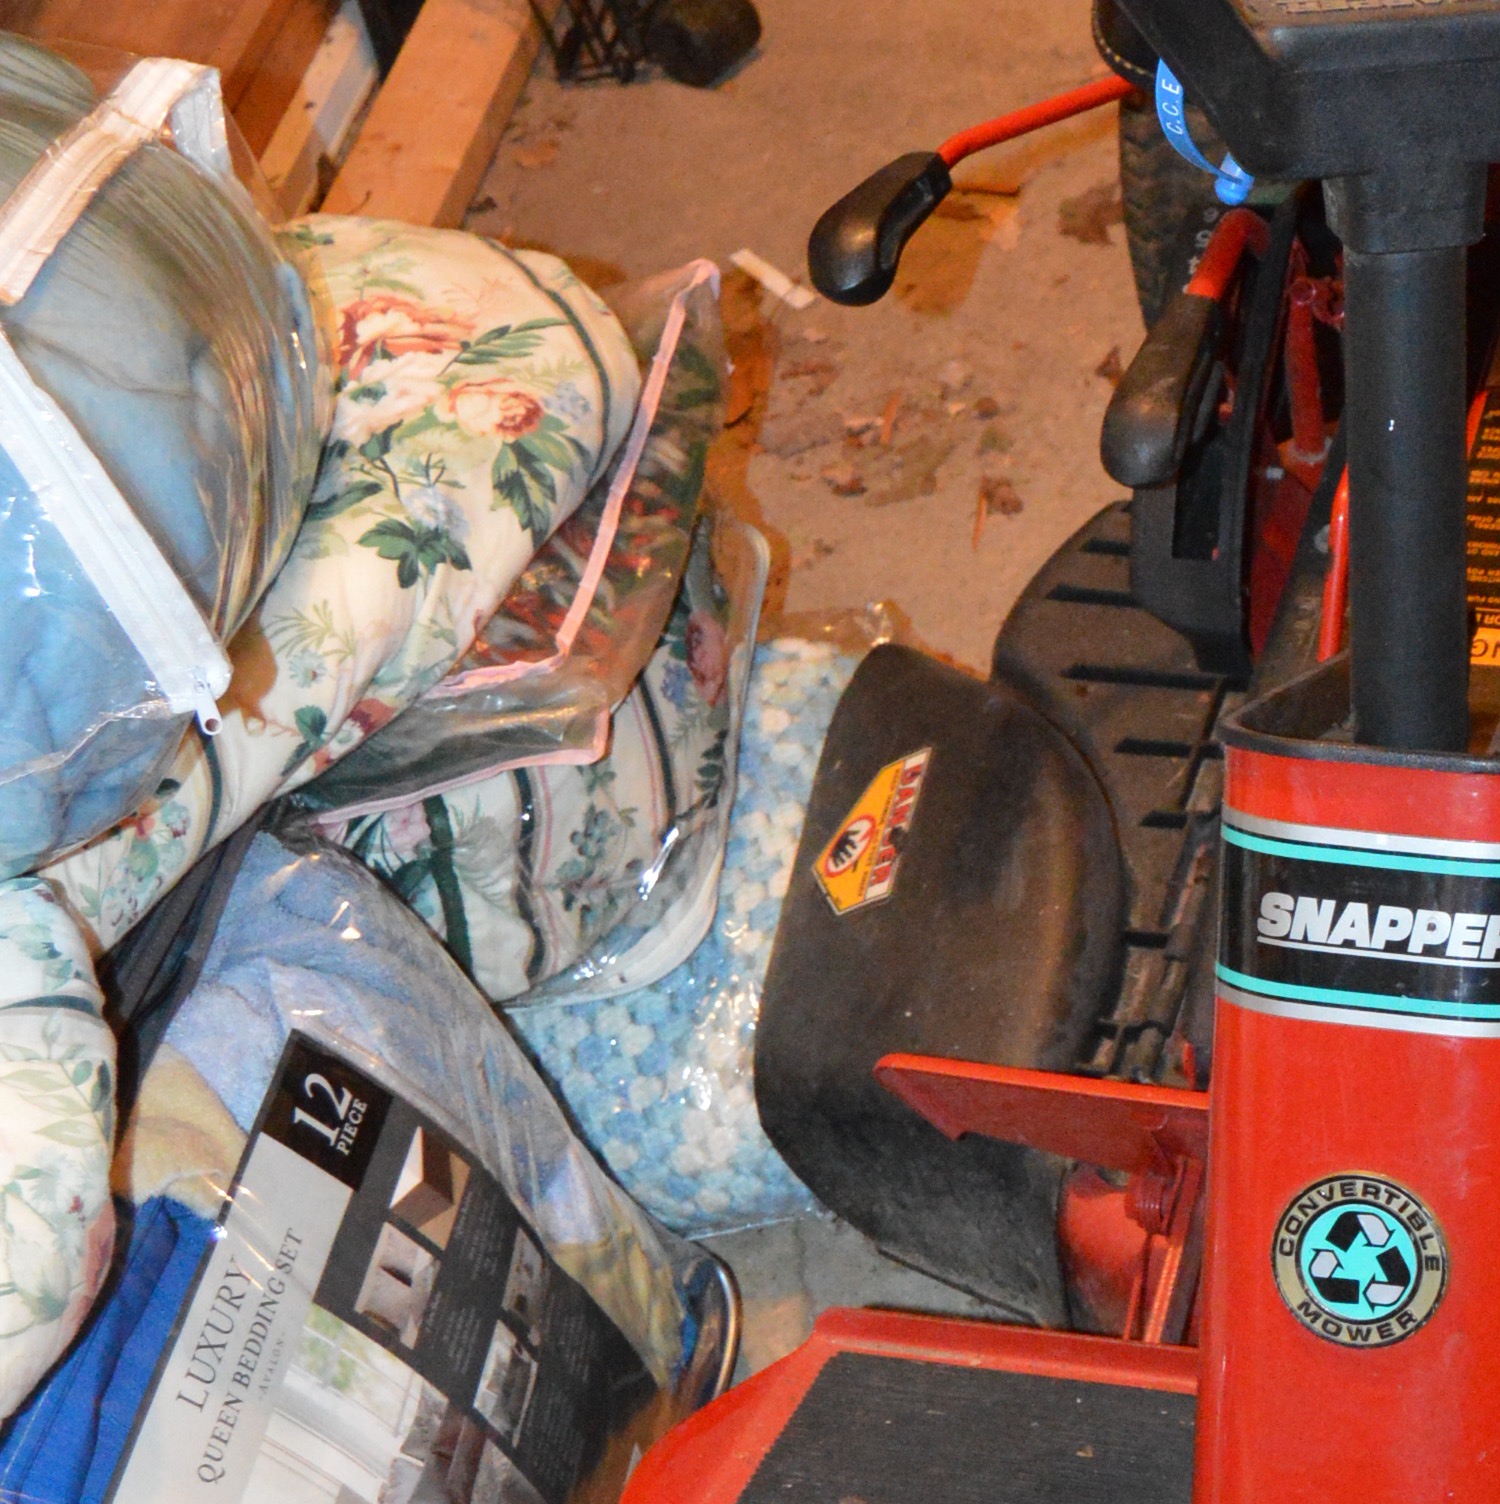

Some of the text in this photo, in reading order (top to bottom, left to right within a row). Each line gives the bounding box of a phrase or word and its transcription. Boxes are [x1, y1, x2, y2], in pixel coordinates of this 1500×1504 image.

[292, 1072, 355, 1147] 12
[336, 1096, 370, 1157] PIECE
[1278, 1181, 1441, 1273] CONVERTIBLE
[176, 1254, 252, 1414] LUXURY
[197, 1227, 304, 1486] QUEEN BEDDING SET
[1297, 1300, 1418, 1343] MOWER
